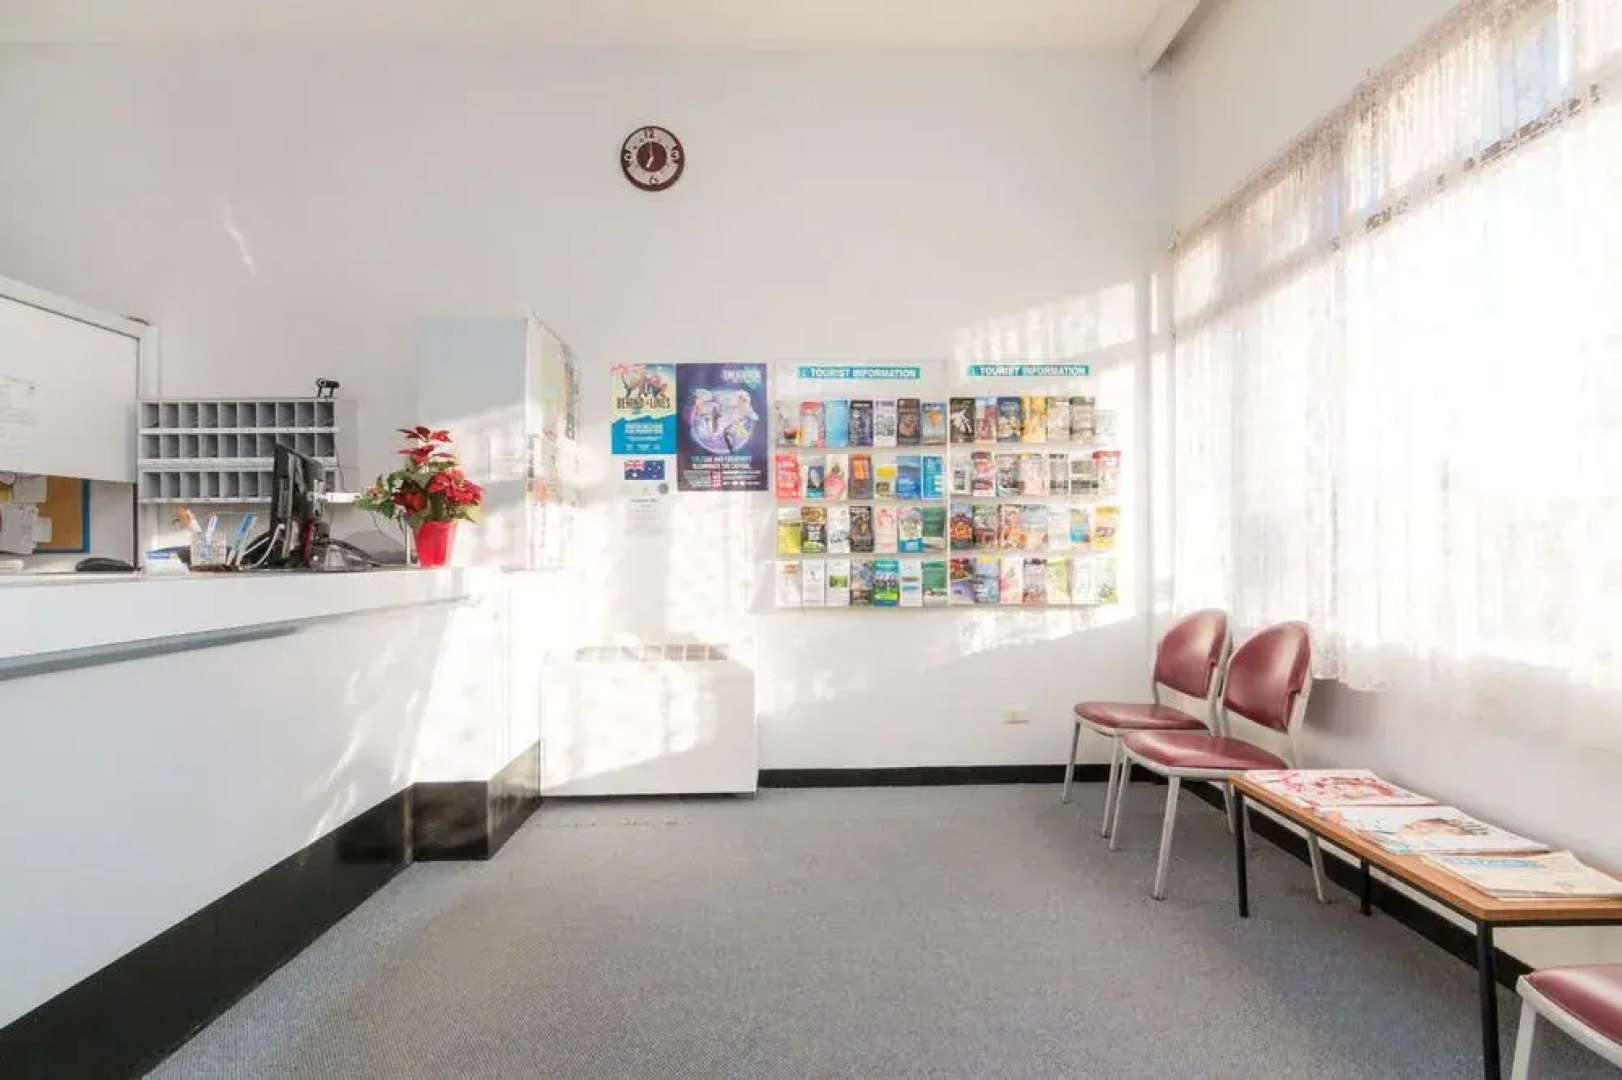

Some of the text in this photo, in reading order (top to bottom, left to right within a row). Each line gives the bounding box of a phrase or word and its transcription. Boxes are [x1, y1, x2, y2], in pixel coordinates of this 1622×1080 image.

[644, 128, 655, 139] 12
[811, 368, 916, 377] TOURIST INFORMATION
[981, 366, 1086, 376] TOURIST INFORMATION
[617, 397, 644, 409] BEHIND
[650, 397, 671, 409] LINES
